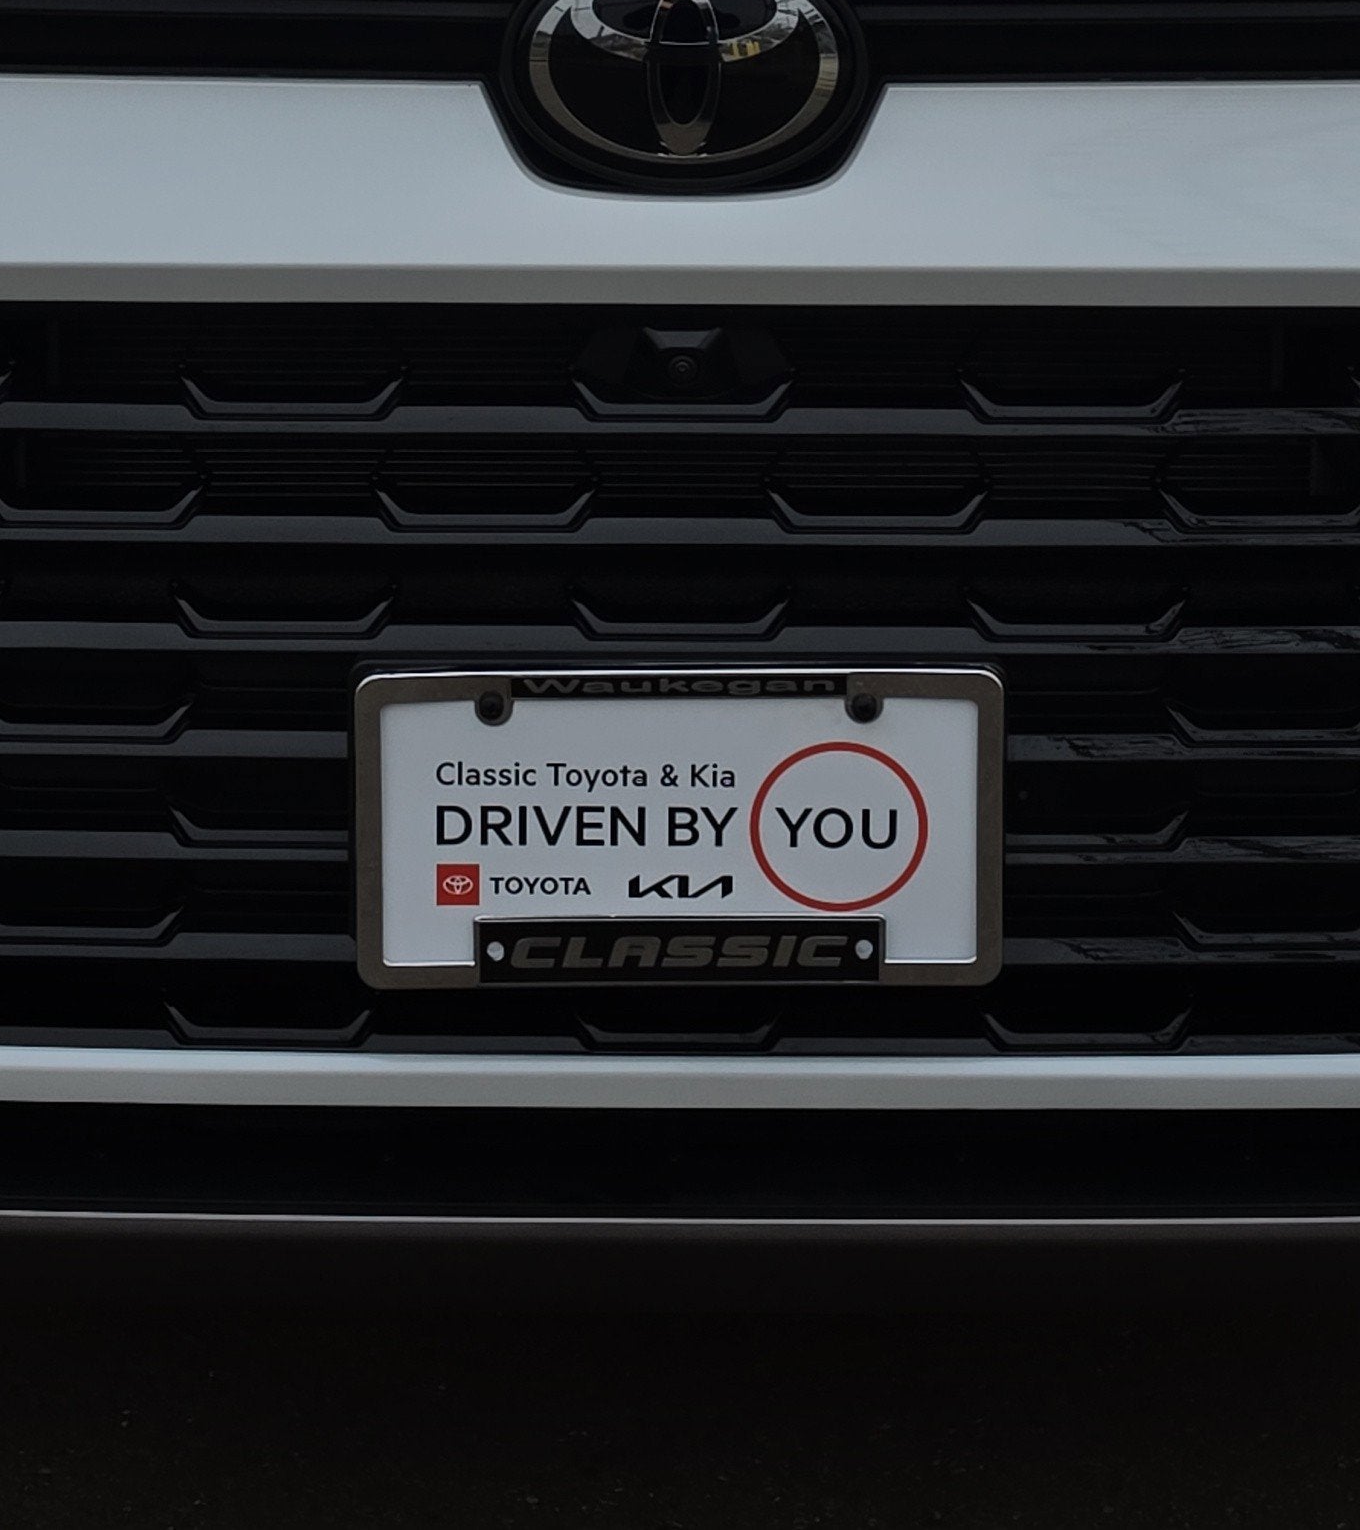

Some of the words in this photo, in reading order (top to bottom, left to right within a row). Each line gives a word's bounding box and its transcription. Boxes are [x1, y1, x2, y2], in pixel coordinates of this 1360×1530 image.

[524, 677, 835, 696] Waukegan
[435, 761, 537, 788] Classic
[545, 762, 648, 793] Toyota
[660, 762, 679, 788] &
[690, 763, 736, 789] Kia
[436, 805, 646, 847] DRIVEN
[667, 806, 739, 848] BY
[774, 807, 898, 850] YOU
[489, 876, 592, 896] TOYOTA
[628, 874, 734, 899] KIA
[510, 934, 848, 968] CLASSIC
